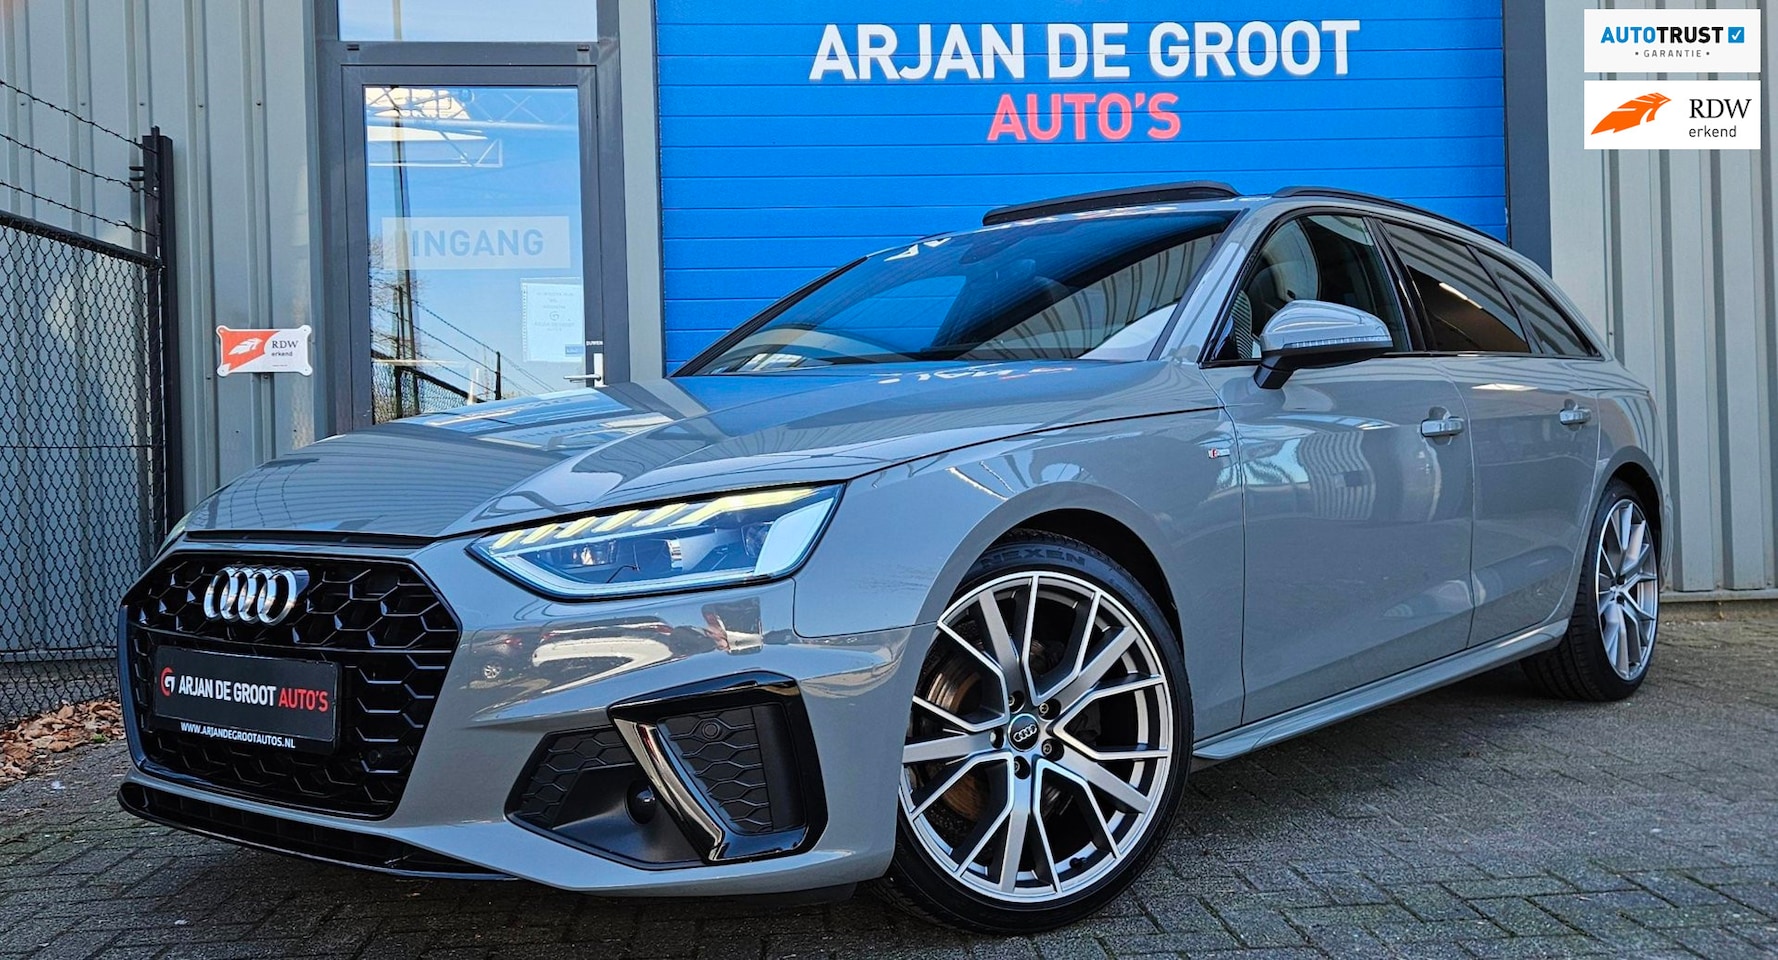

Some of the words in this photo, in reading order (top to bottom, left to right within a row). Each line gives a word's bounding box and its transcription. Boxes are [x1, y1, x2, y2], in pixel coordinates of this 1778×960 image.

[808, 23, 1025, 80] ARJAN
[1047, 22, 1130, 78] DE
[1149, 19, 1361, 77] GROOT
[987, 92, 1181, 141] AUTO'S
[412, 229, 544, 257] INGANG
[271, 340, 299, 349] RDW
[980, 548, 1086, 569] NEXEN
[178, 674, 214, 699] ARJAN
[215, 679, 232, 701] DE
[233, 682, 277, 706] GROOT
[278, 687, 329, 713] AUTO'S
[180, 721, 296, 749] WWW.ARJANDEGROOTAUTOS.NL
